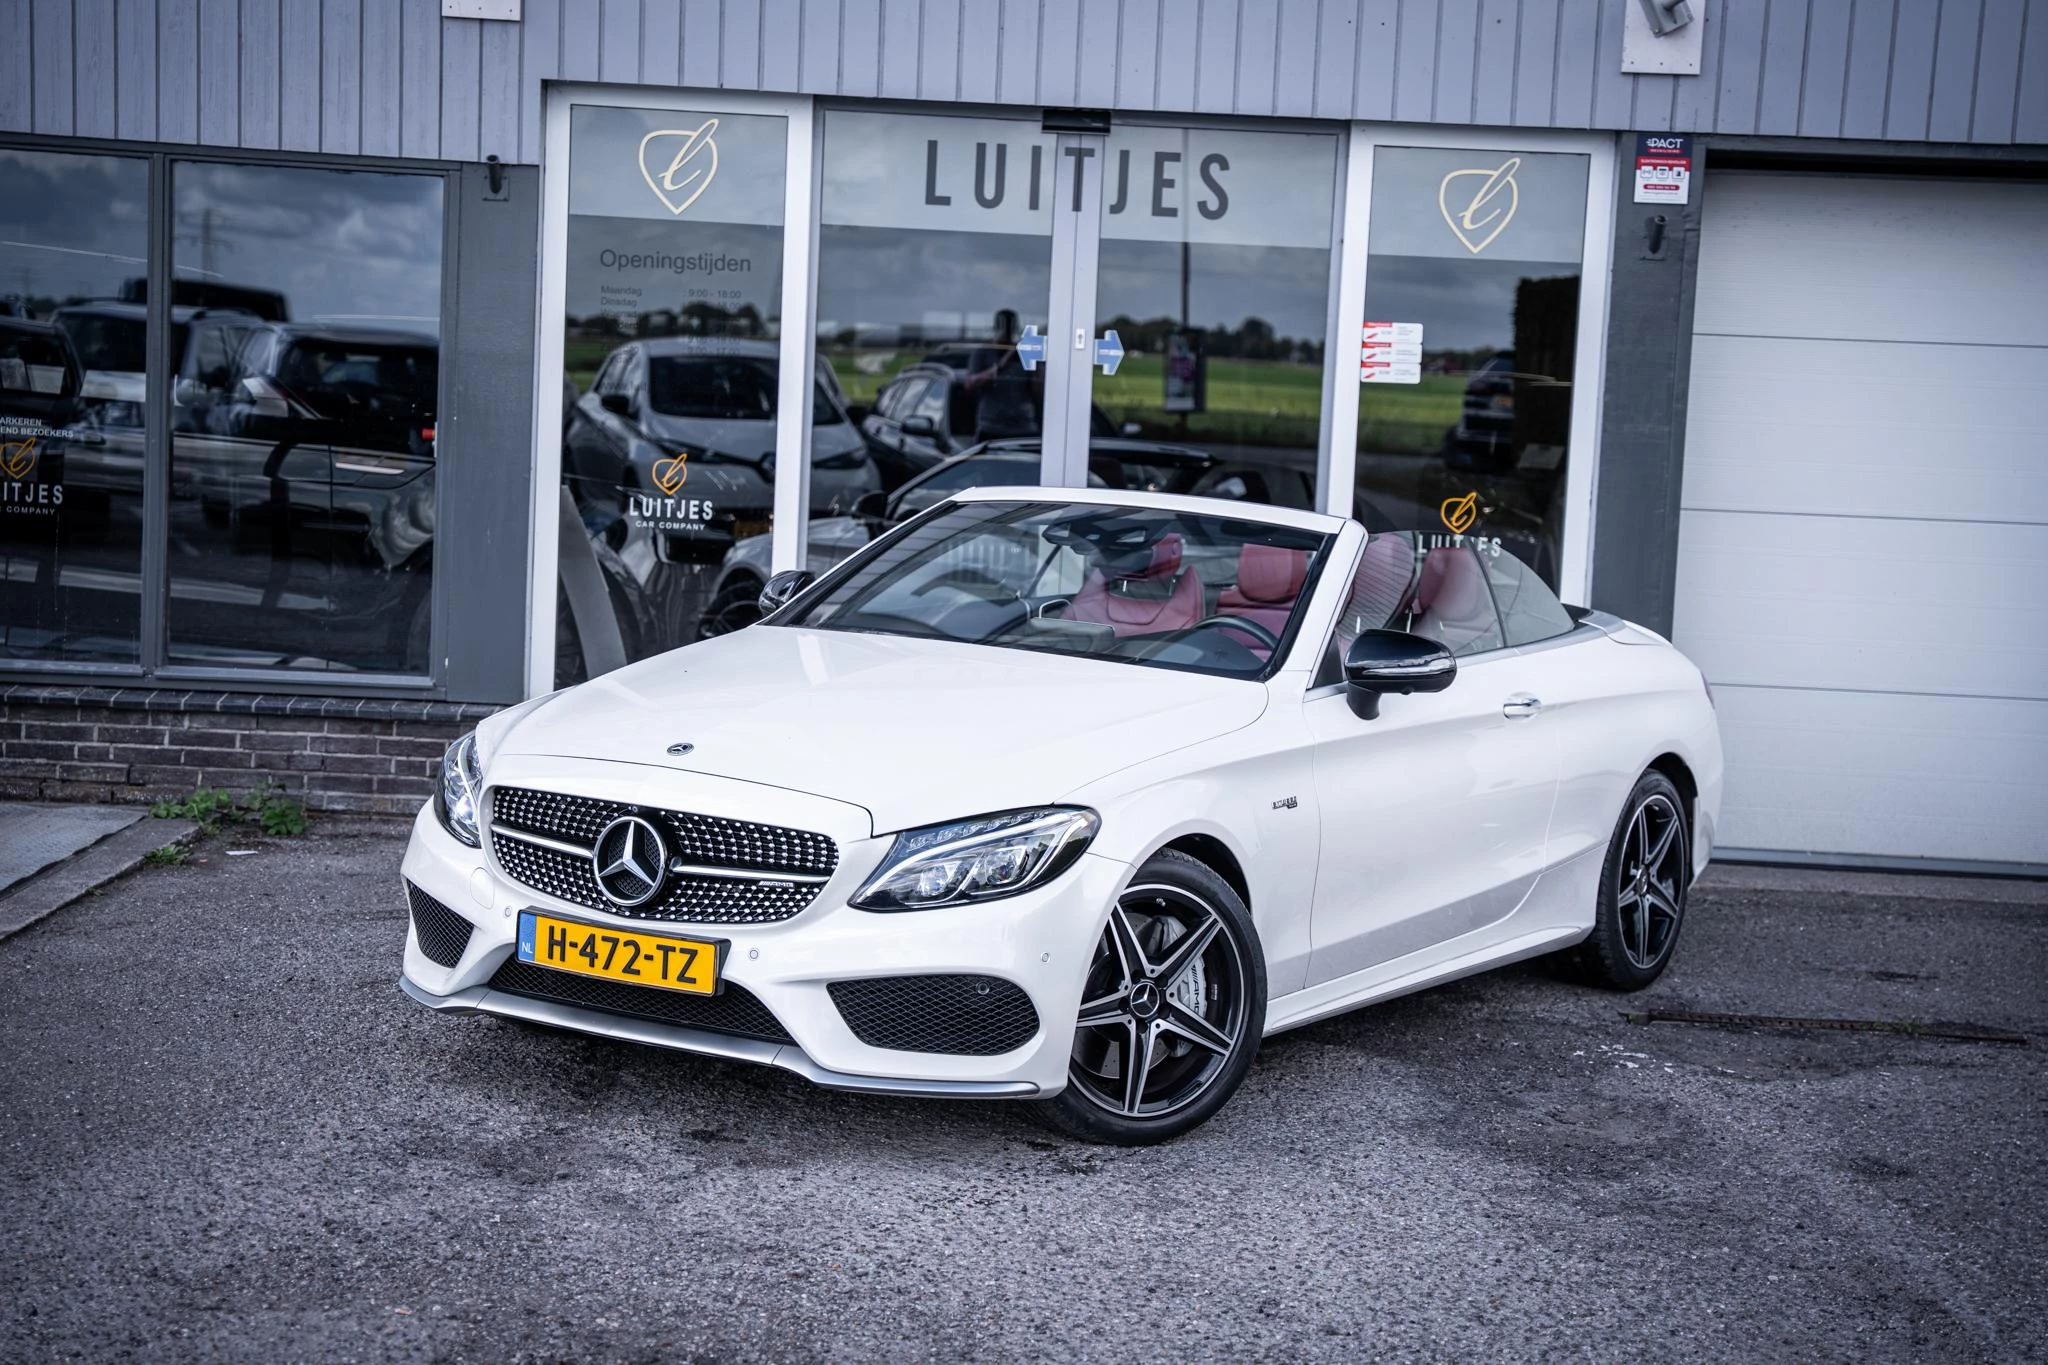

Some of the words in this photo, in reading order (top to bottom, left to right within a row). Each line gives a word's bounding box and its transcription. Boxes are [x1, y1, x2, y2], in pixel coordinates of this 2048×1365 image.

[1648, 138, 1684, 148] PACT
[924, 139, 1230, 220] LUITJES
[600, 249, 751, 275] Openingstijden
[20, 427, 74, 438] BEZOEKERS
[6, 505, 56, 516] COMPANY
[629, 497, 713, 521] LUITJES
[635, 520, 655, 528] CAR
[658, 521, 706, 531] COMPANY
[521, 941, 533, 954] NL
[547, 925, 698, 984] H-472-TZ
